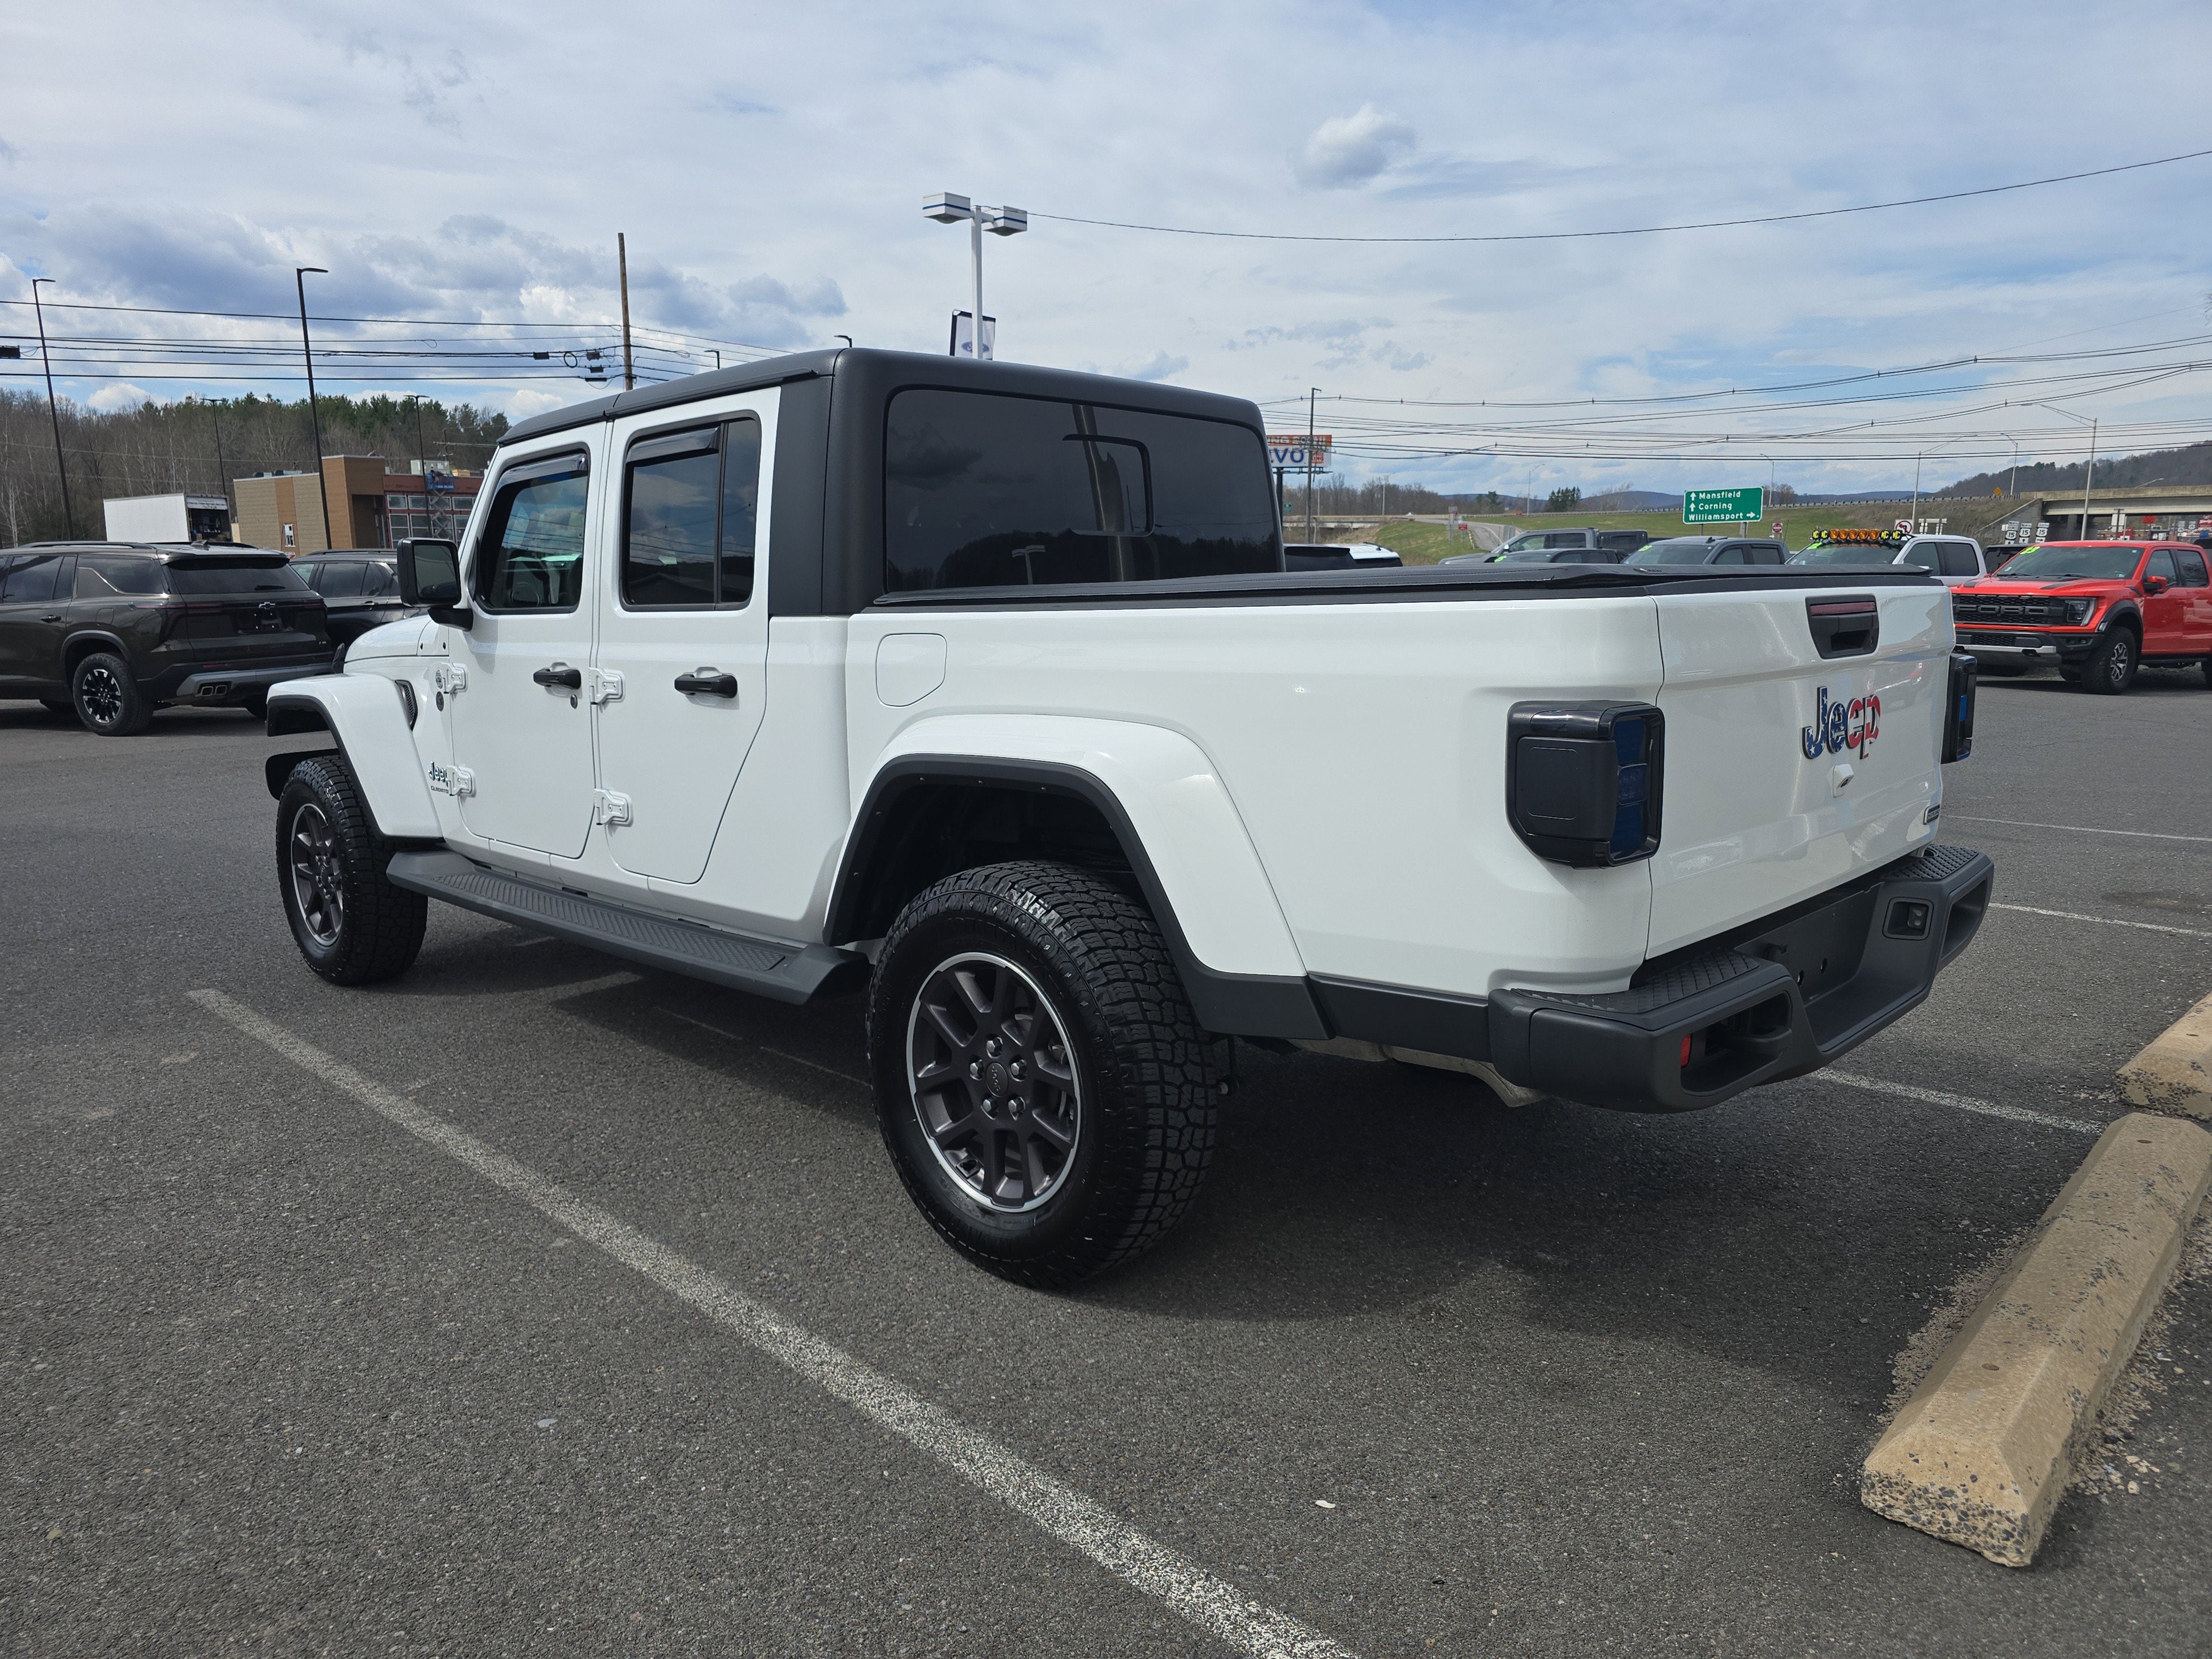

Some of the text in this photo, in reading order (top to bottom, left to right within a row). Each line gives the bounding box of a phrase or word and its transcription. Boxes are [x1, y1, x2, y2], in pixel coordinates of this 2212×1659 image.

[1699, 491, 1741, 499] Mansfield
[1698, 502, 1732, 510] Corning
[1688, 512, 1744, 521] Williamsport
[1881, 530, 1889, 539] KC
[1893, 531, 1901, 539] KC
[1954, 603, 2049, 616] FORD
[1802, 685, 1881, 760] Jeep
